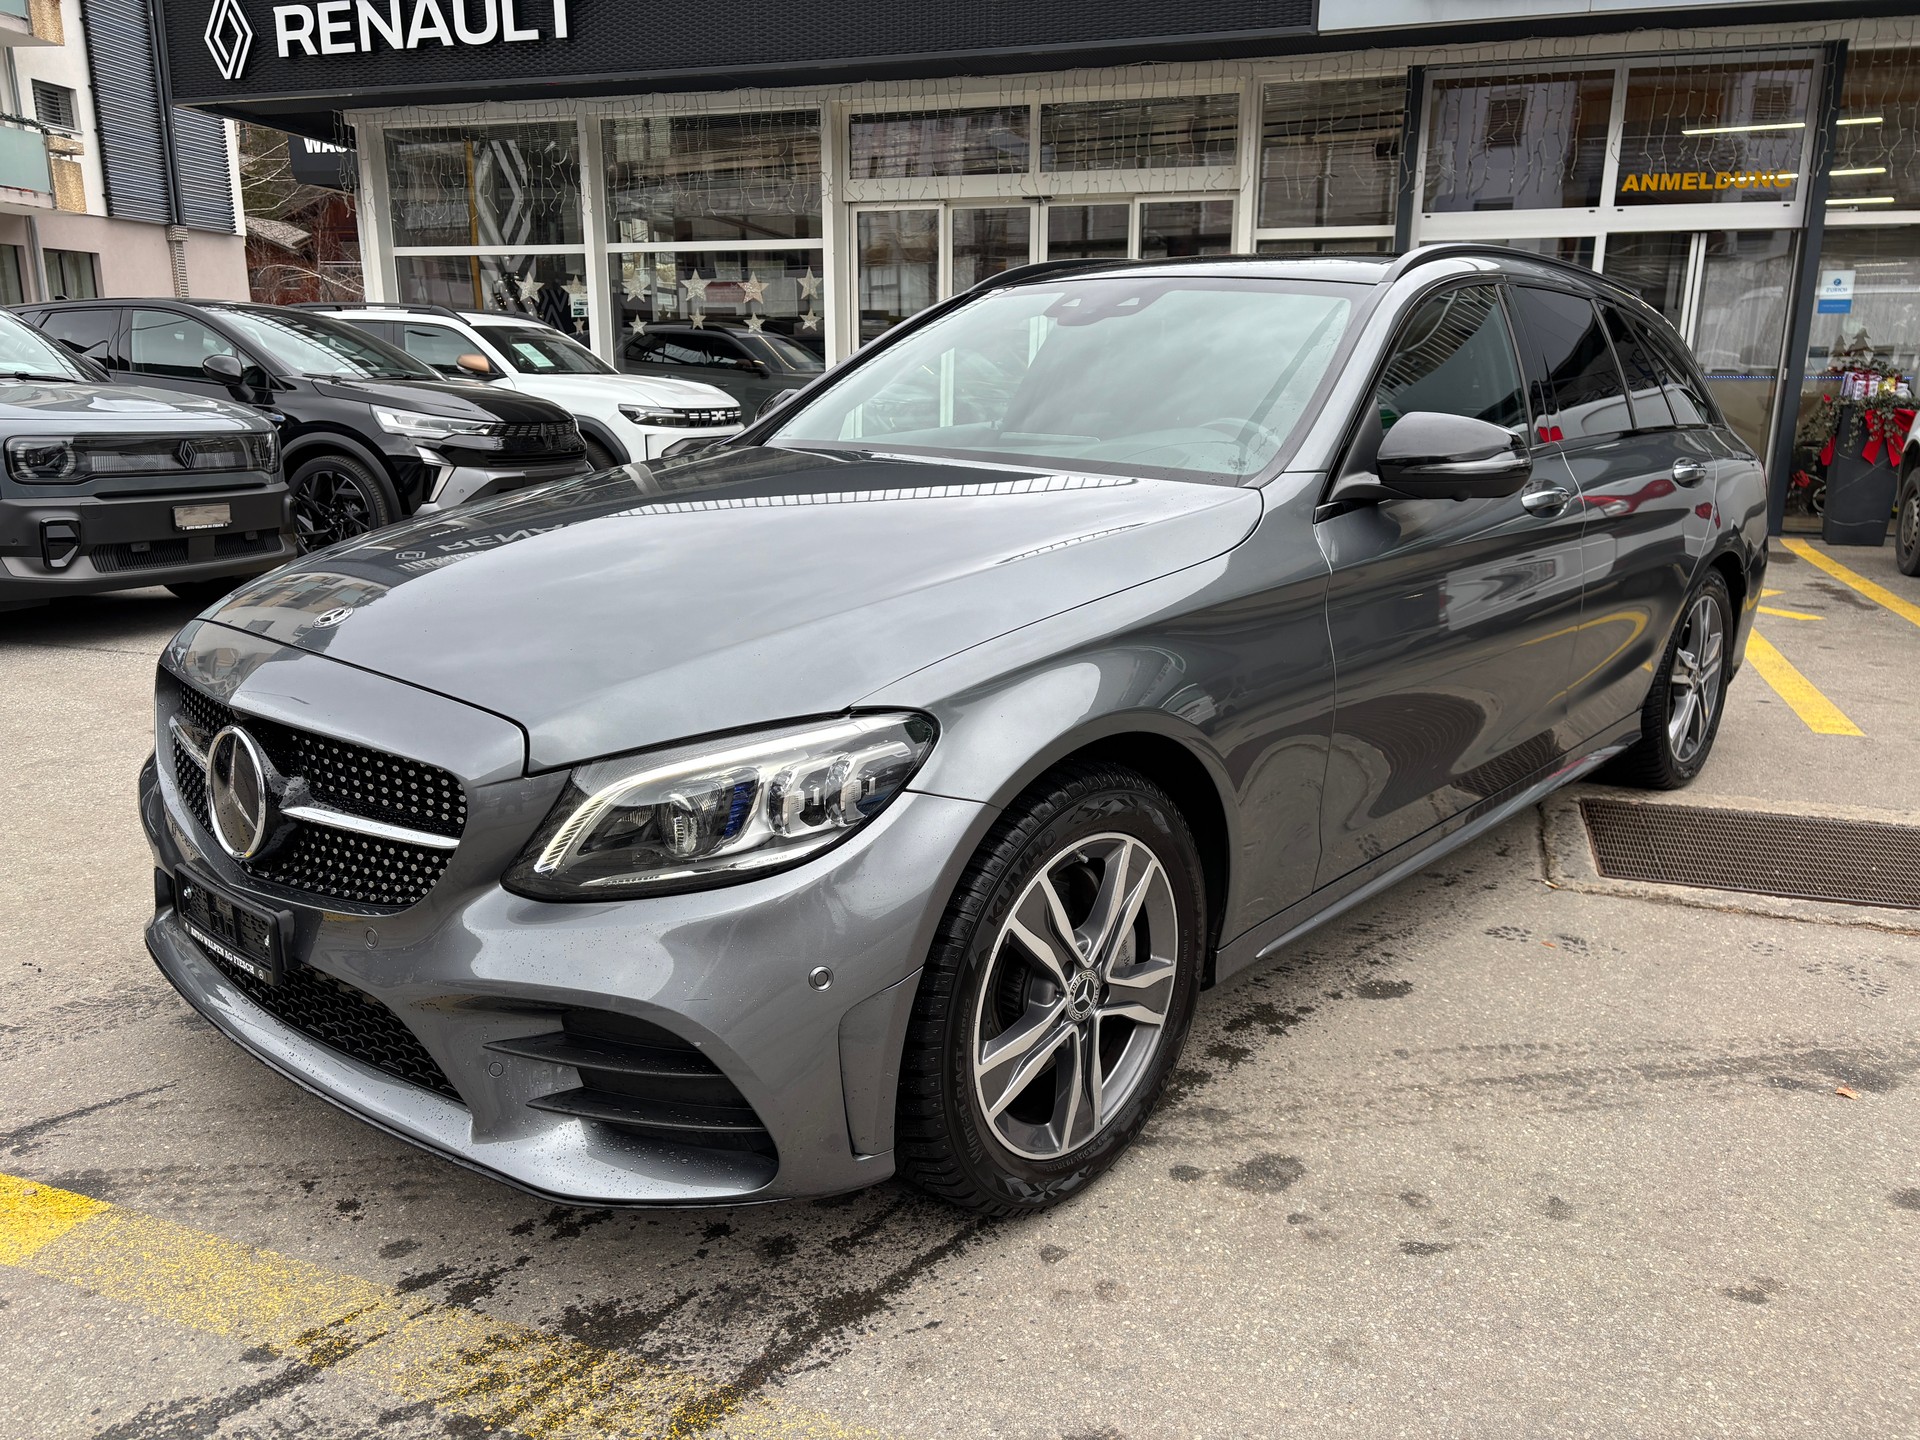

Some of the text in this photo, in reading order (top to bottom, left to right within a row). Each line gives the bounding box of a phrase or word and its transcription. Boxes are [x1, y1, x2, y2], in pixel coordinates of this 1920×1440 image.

[273, 0, 568, 58] RENAULT
[1621, 170, 1792, 193] ANMELDUNG
[987, 826, 1057, 927] KUMHO
